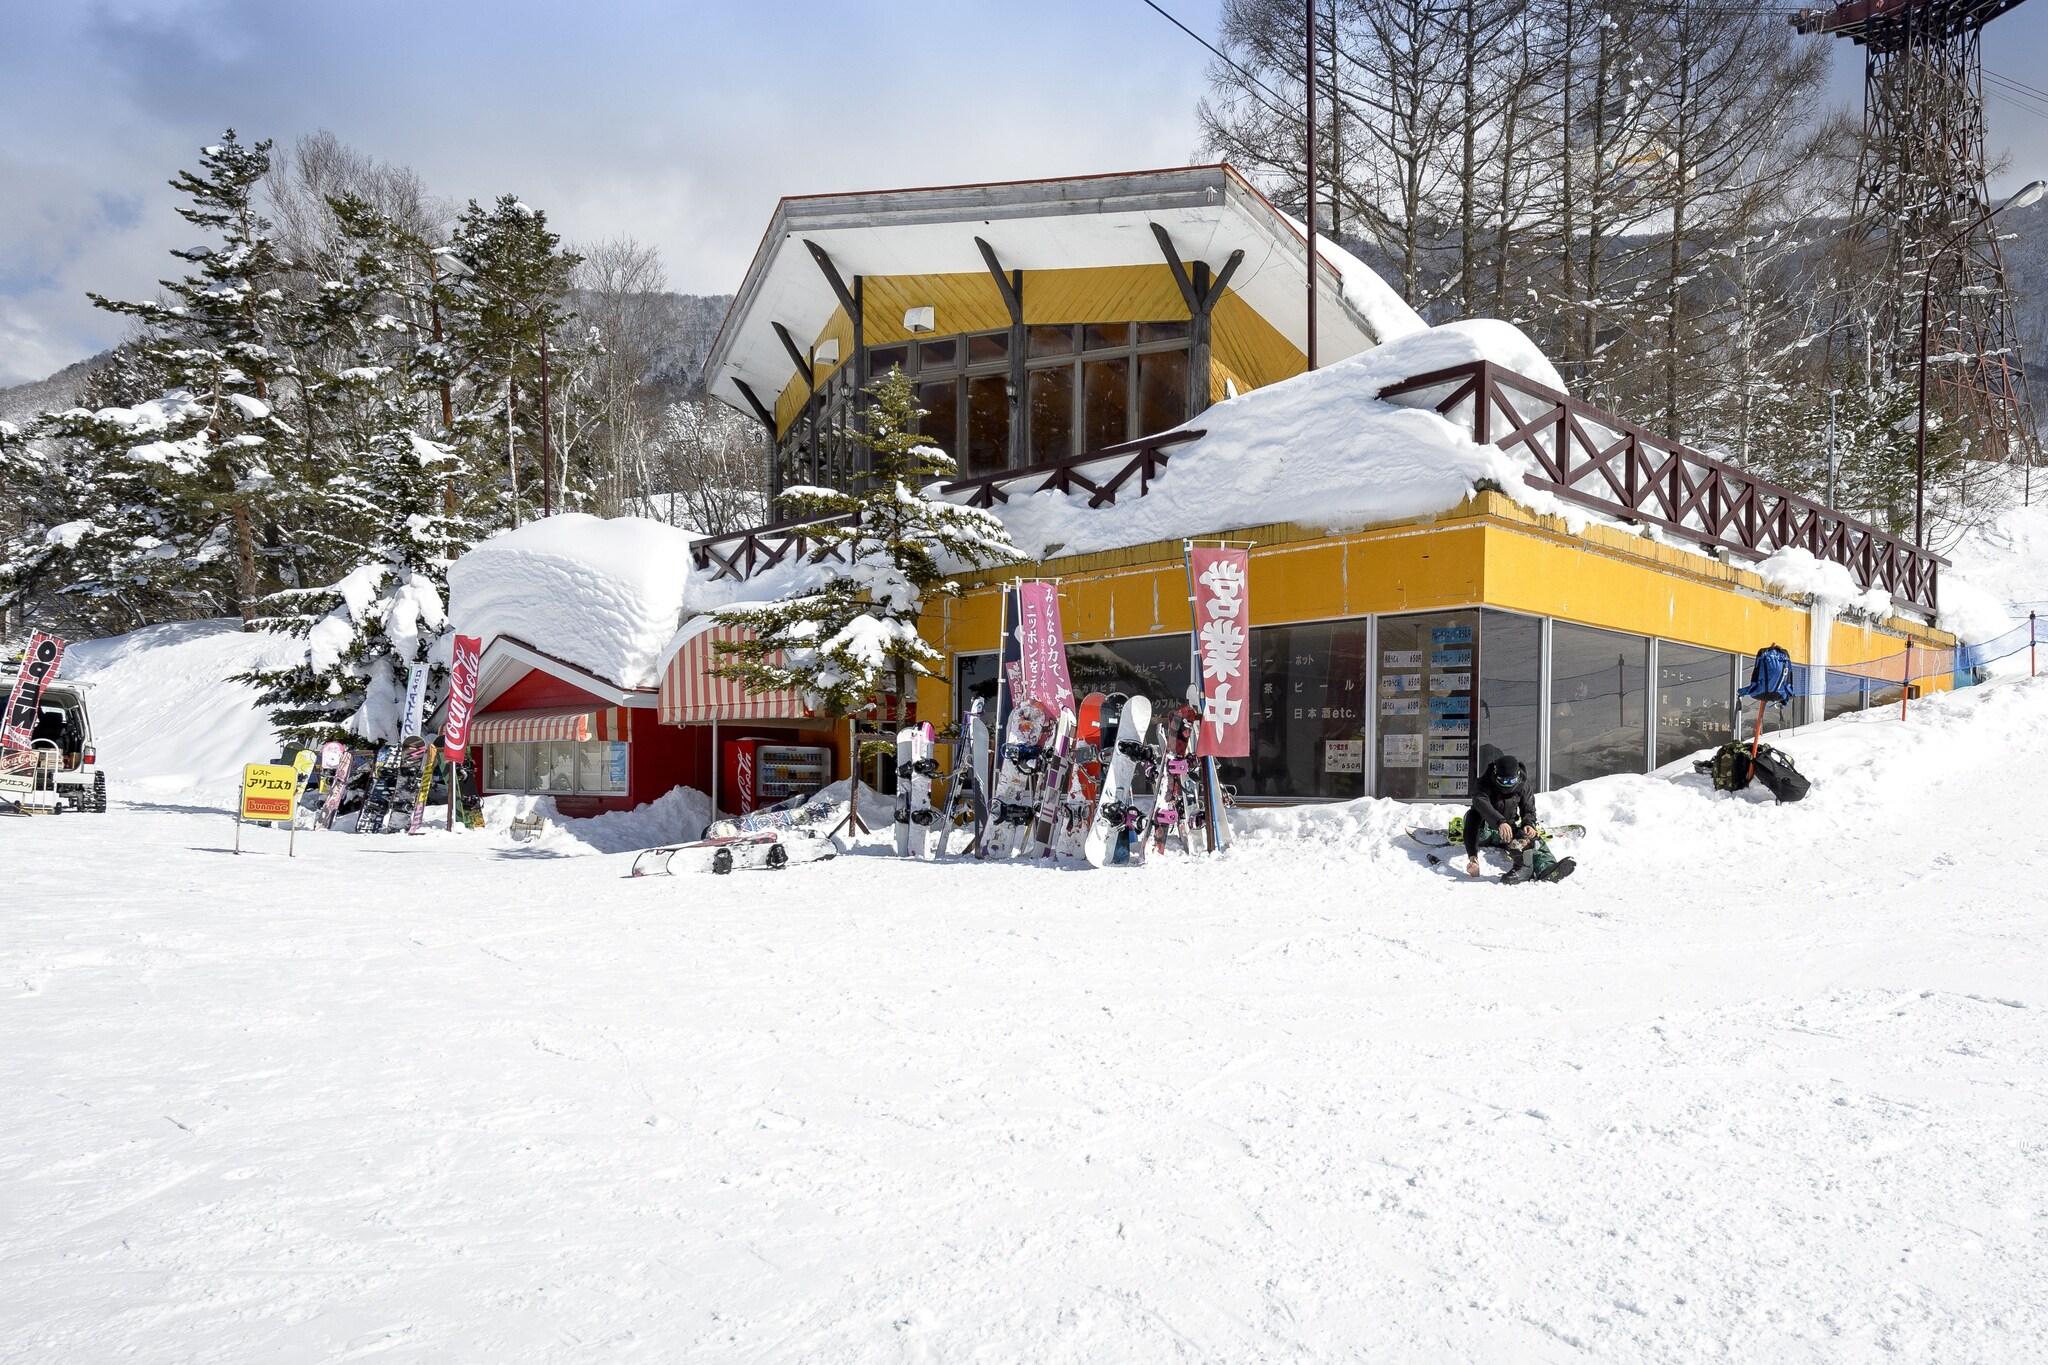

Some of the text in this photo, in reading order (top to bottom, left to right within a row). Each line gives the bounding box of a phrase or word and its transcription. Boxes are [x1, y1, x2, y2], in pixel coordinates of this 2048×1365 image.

[1199, 560, 1245, 744] 営業中
[444, 642, 479, 751] Coca-Cola
[246, 778, 292, 790] アリエスカ
[253, 769, 271, 777] レスト
